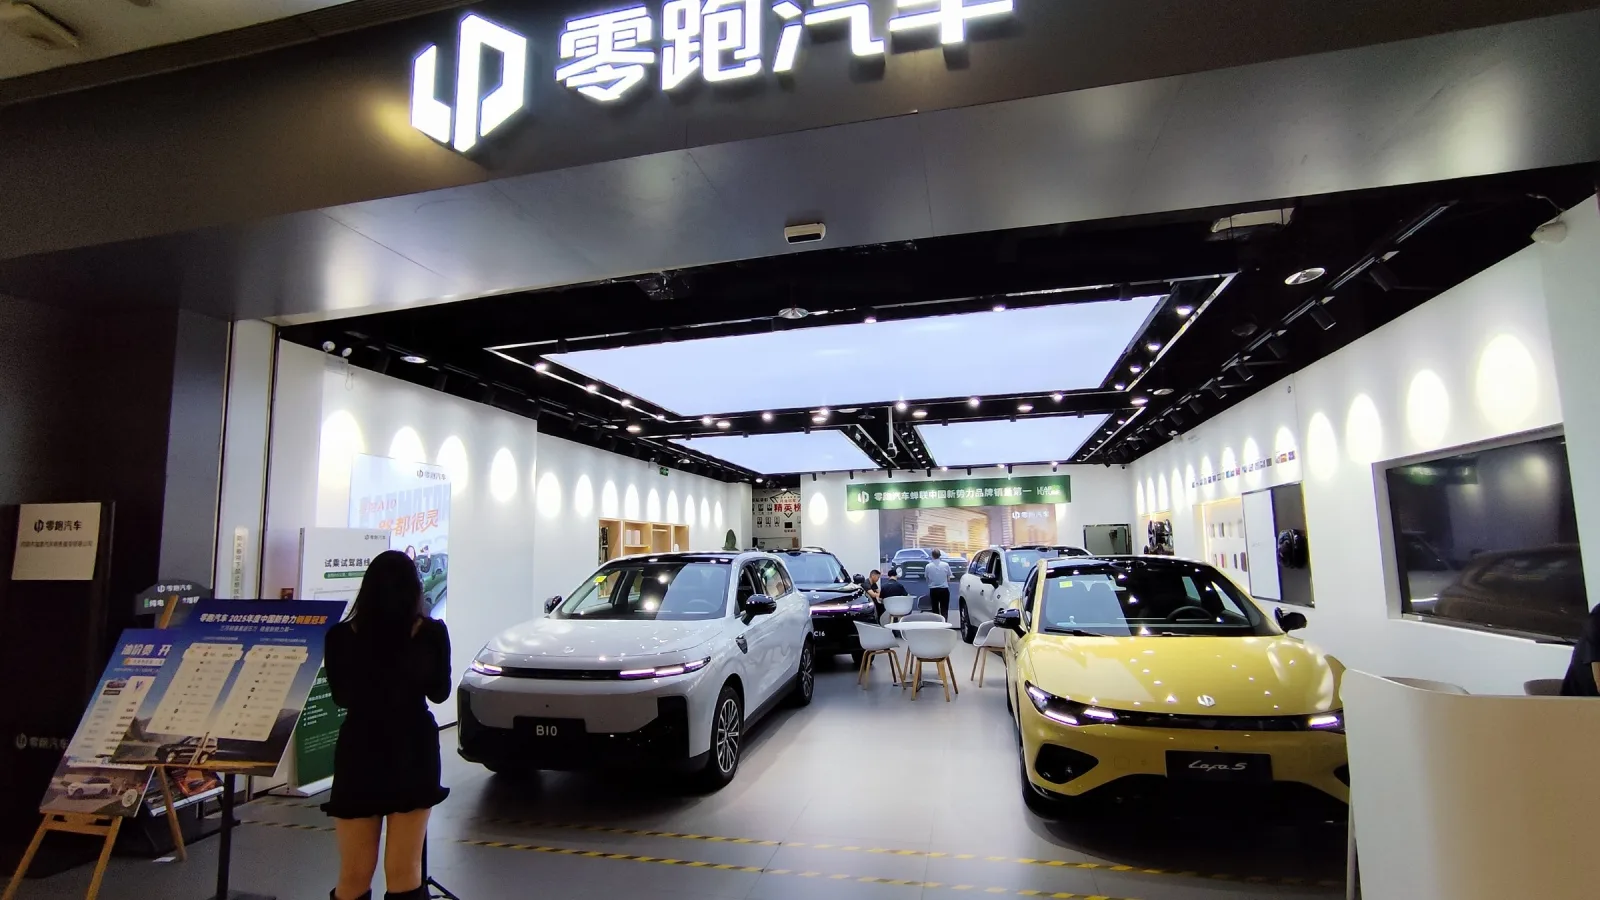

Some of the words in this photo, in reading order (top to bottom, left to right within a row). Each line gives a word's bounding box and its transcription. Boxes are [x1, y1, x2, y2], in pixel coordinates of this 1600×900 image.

[555, 0, 1017, 102] 零跑汽车
[424, 471, 447, 480] 零跑汽车
[873, 486, 1032, 501] 零跑汽车蝉联中国新势力品牌销量第一
[45, 520, 82, 531] 零跑汽车
[166, 584, 192, 592] 零跑汽车
[200, 613, 228, 623] 零跑汽车
[535, 725, 558, 737] B10
[1231, 759, 1248, 771] 5
